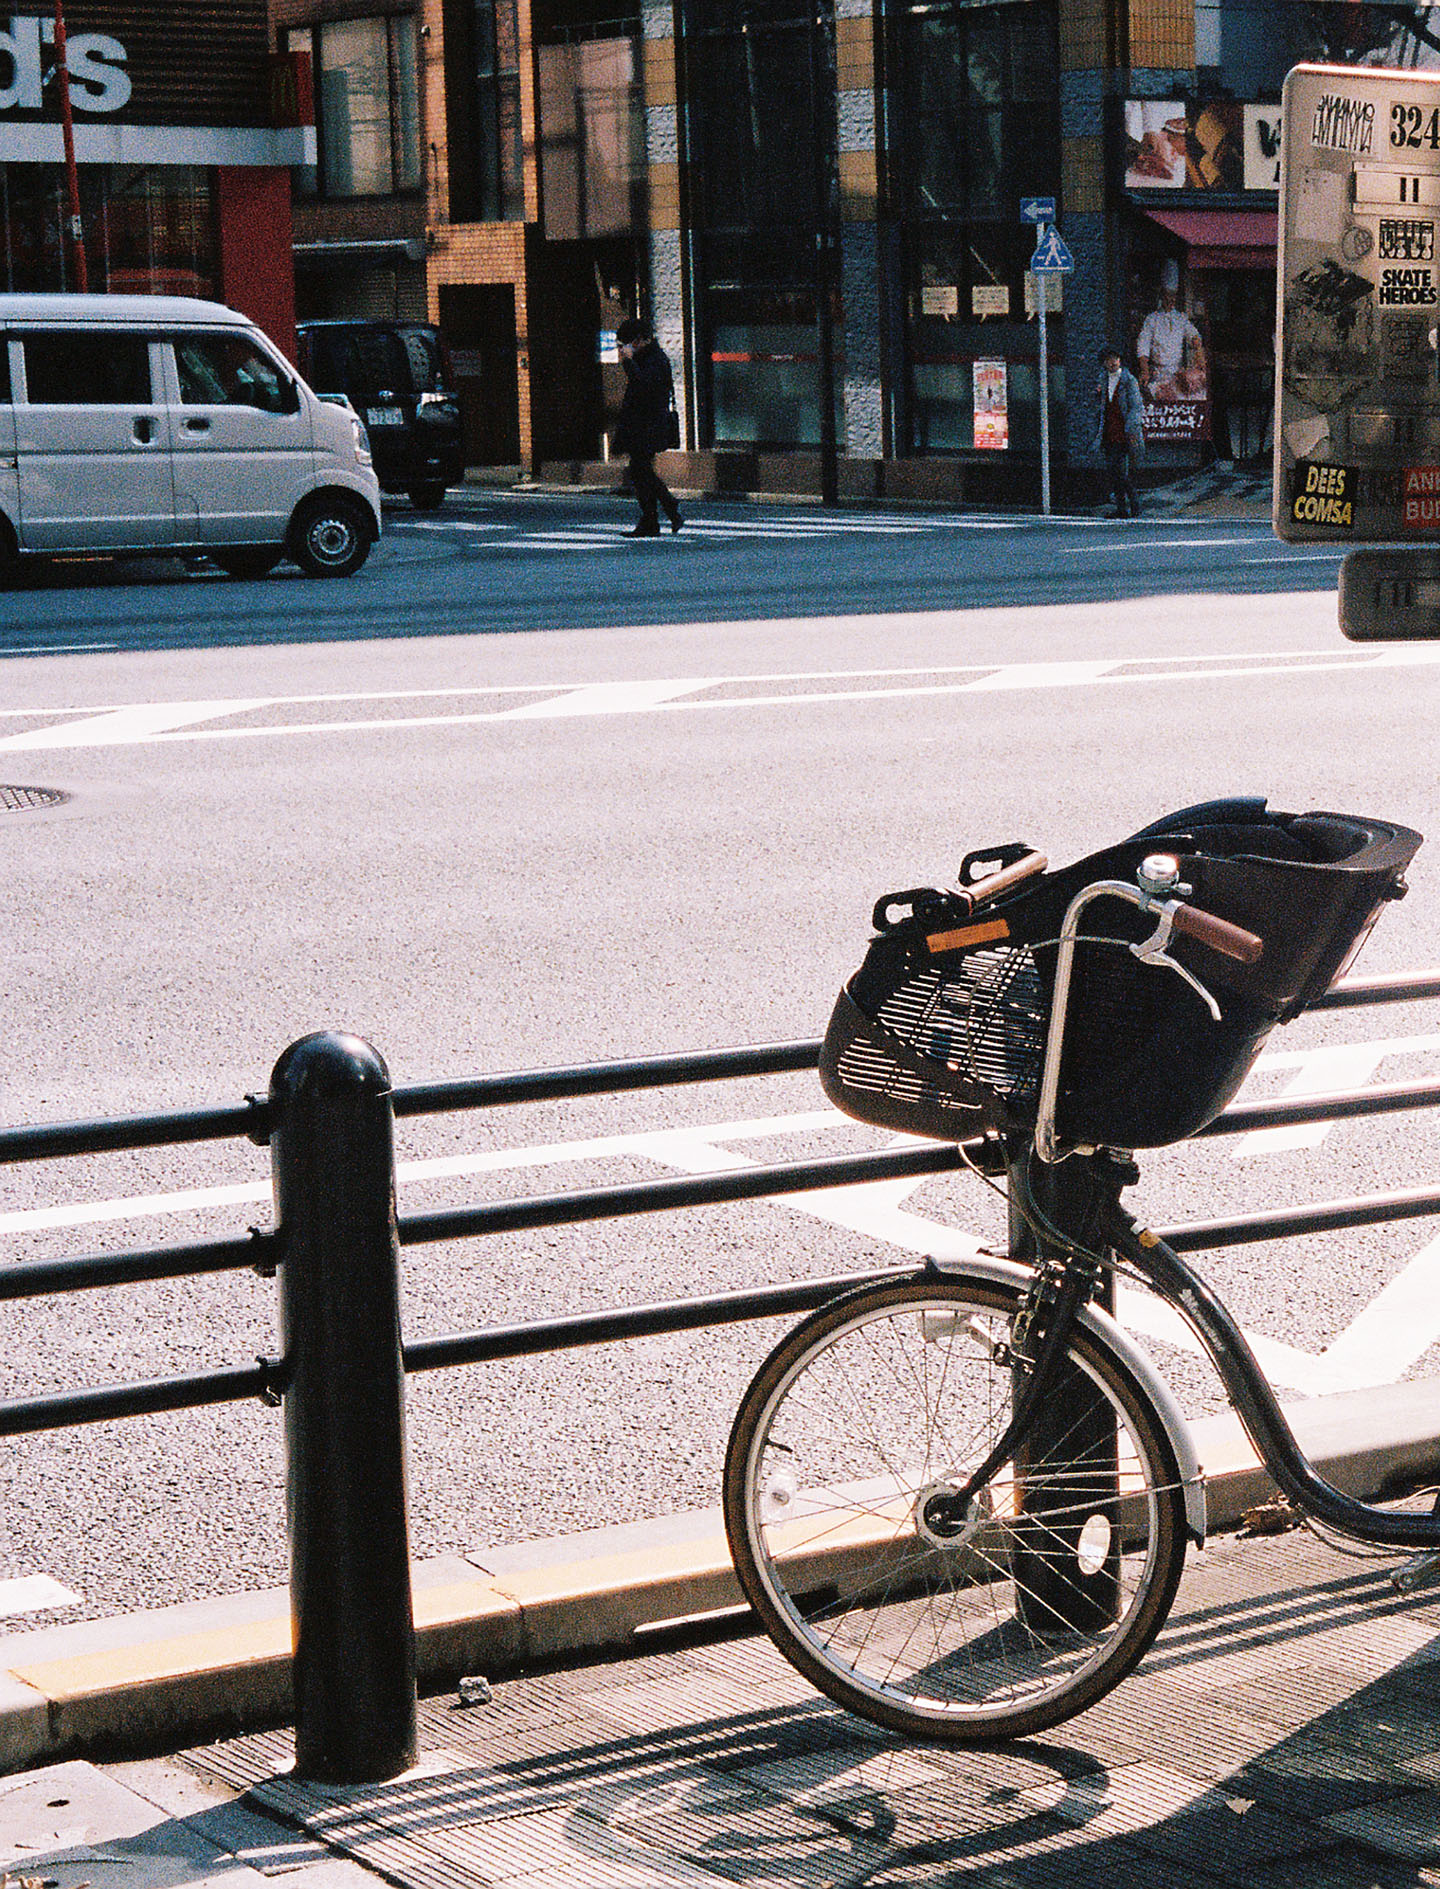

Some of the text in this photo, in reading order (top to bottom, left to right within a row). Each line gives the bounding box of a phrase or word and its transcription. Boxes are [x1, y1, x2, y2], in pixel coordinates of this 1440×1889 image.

[1391, 104, 1440, 149] 324
[1382, 269, 1431, 287] SKATE
[1379, 287, 1437, 304] HEROES
[1305, 465, 1346, 496] DEES
[1294, 495, 1352, 525] COMSA
